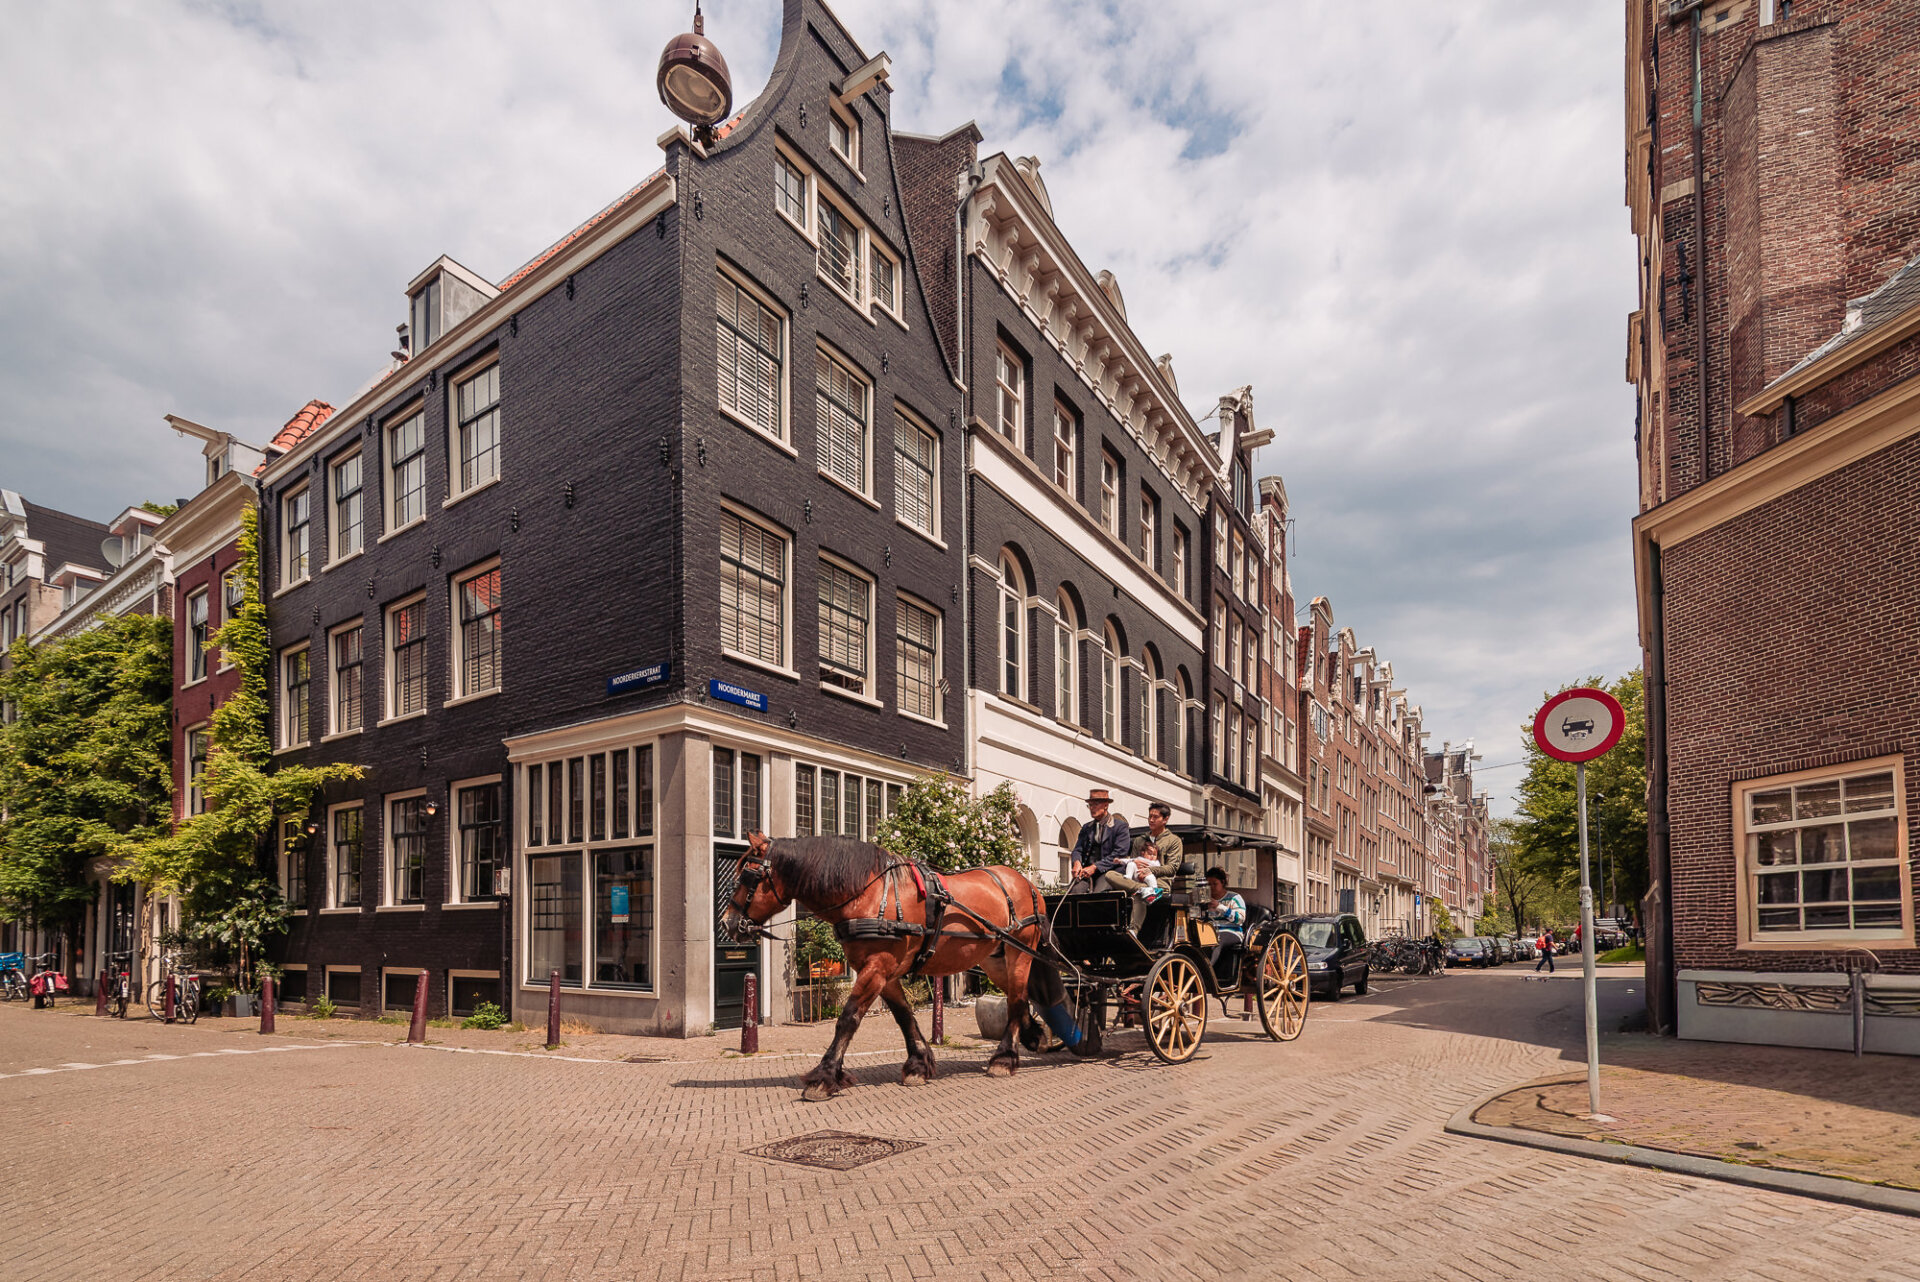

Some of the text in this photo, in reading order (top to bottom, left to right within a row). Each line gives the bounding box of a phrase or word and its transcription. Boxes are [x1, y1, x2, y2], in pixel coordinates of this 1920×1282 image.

[612, 666, 661, 685] NOORDERKERKSTRAAT
[718, 682, 760, 701] NOORDERMARKT
[745, 699, 761, 707] CENTRUM
